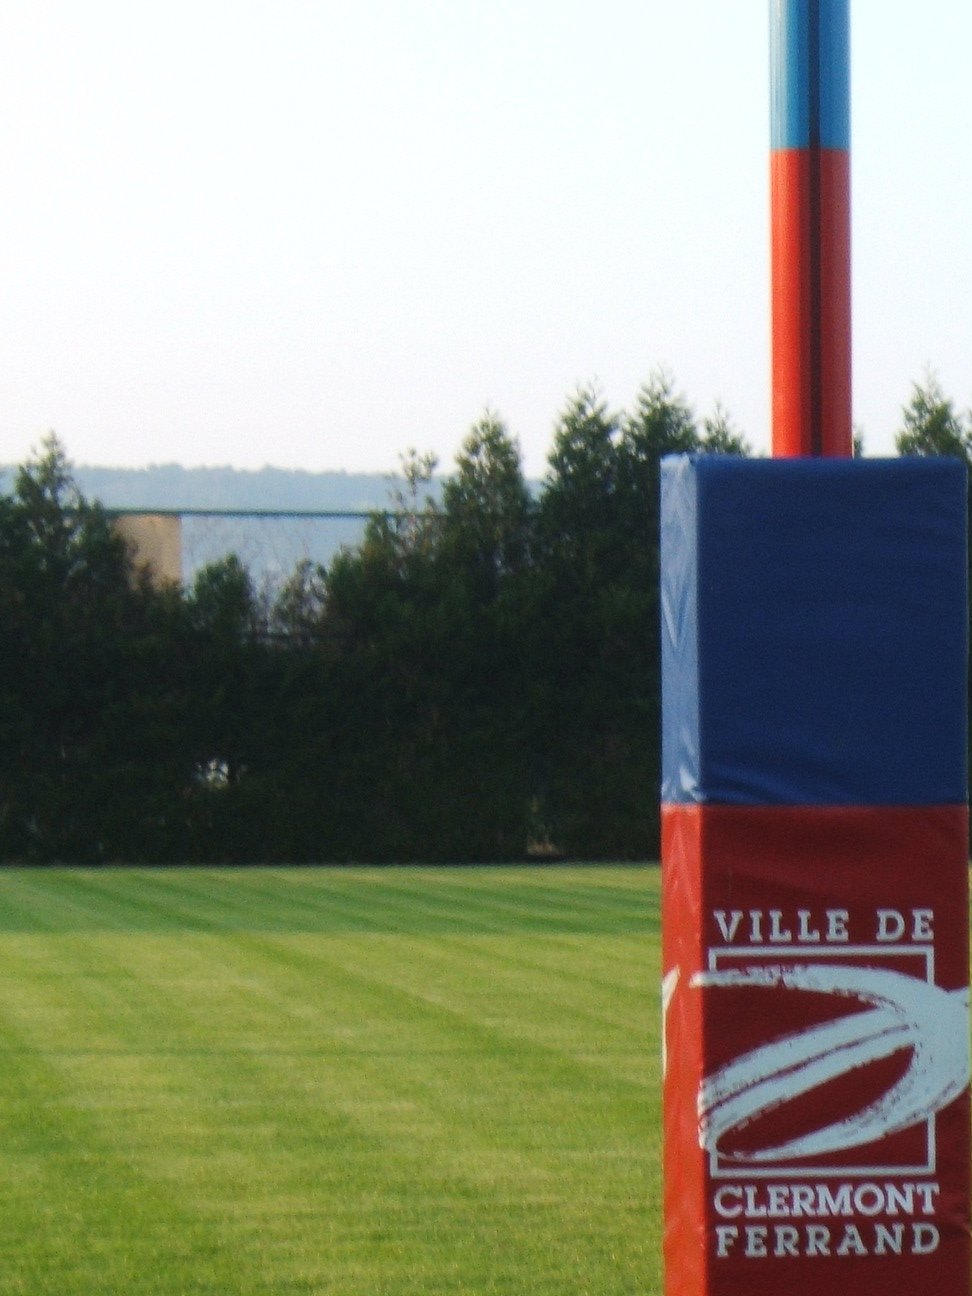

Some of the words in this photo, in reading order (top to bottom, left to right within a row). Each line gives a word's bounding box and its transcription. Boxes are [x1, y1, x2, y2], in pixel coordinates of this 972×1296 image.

[713, 909, 850, 942] VILLE
[876, 909, 934, 941] DE
[713, 1182, 940, 1218] CLERMONT
[715, 1223, 940, 1257] FERRAND
